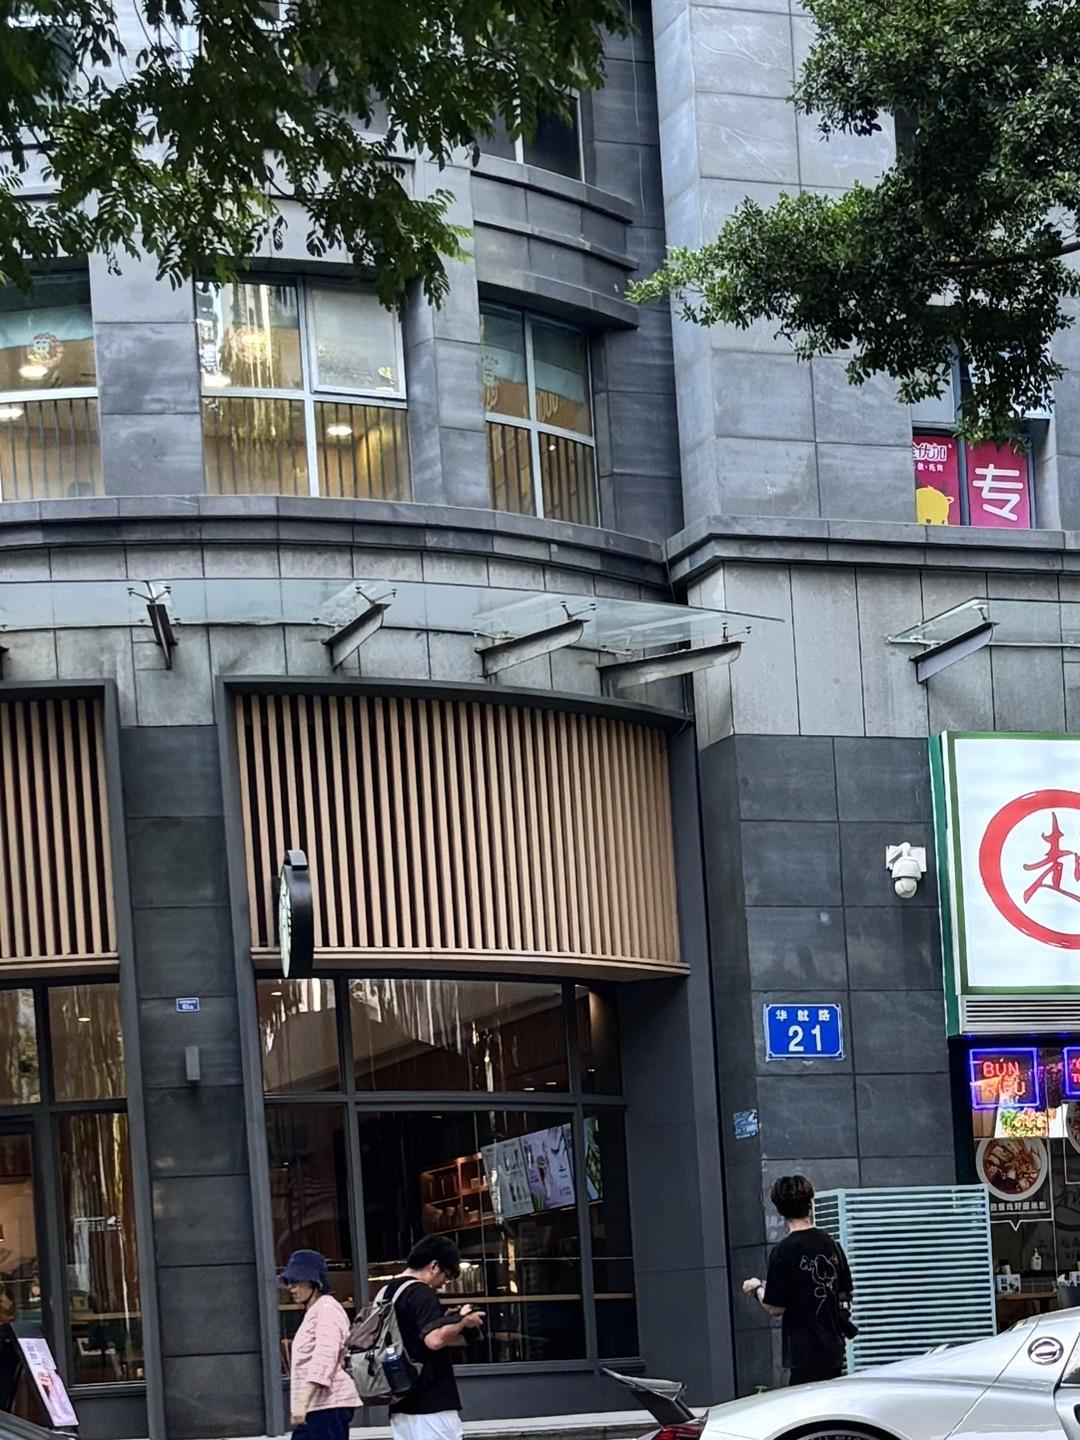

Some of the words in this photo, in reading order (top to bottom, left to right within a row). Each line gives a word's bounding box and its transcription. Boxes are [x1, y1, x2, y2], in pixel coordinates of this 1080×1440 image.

[973, 464, 1024, 521] 专
[788, 1025, 823, 1051] 21
[983, 1058, 1020, 1077] BÚN
